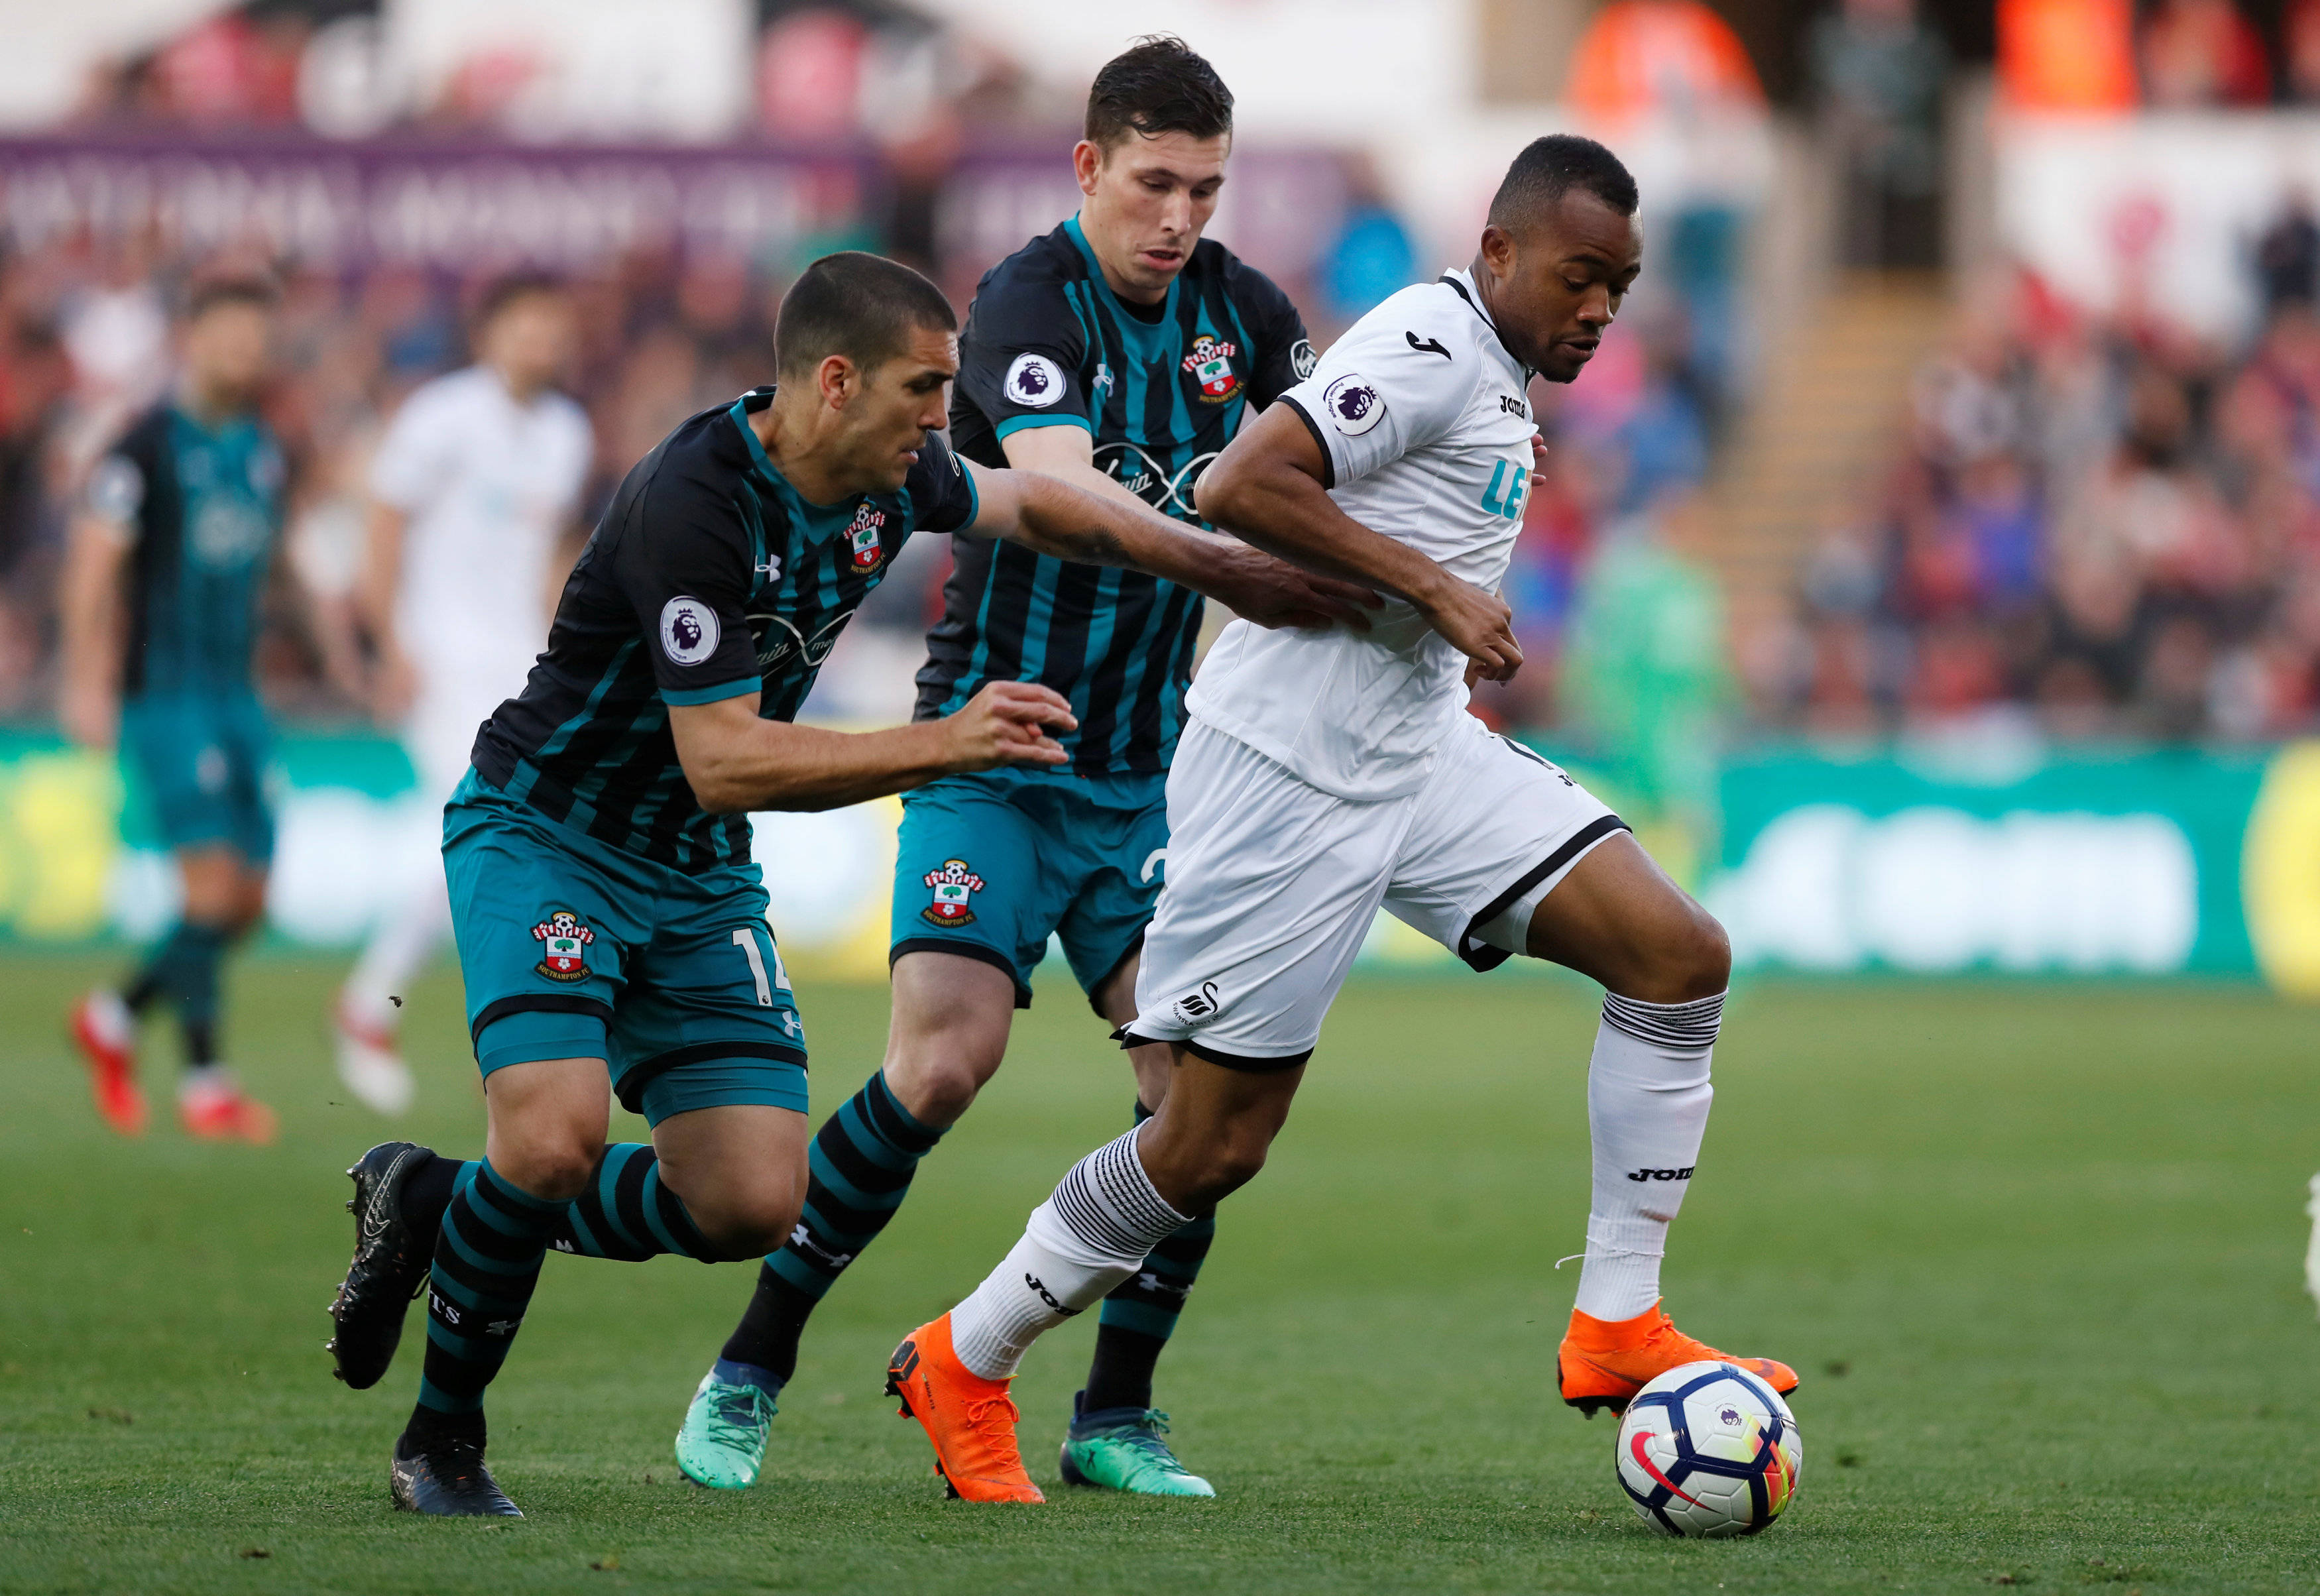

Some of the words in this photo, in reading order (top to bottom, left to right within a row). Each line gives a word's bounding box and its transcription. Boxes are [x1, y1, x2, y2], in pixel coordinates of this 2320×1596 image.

[1328, 398, 1337, 418] League
[538, 964, 581, 980] SOUTHAMPTON
[581, 967, 591, 976] FC
[428, 1279, 460, 1324] TS
